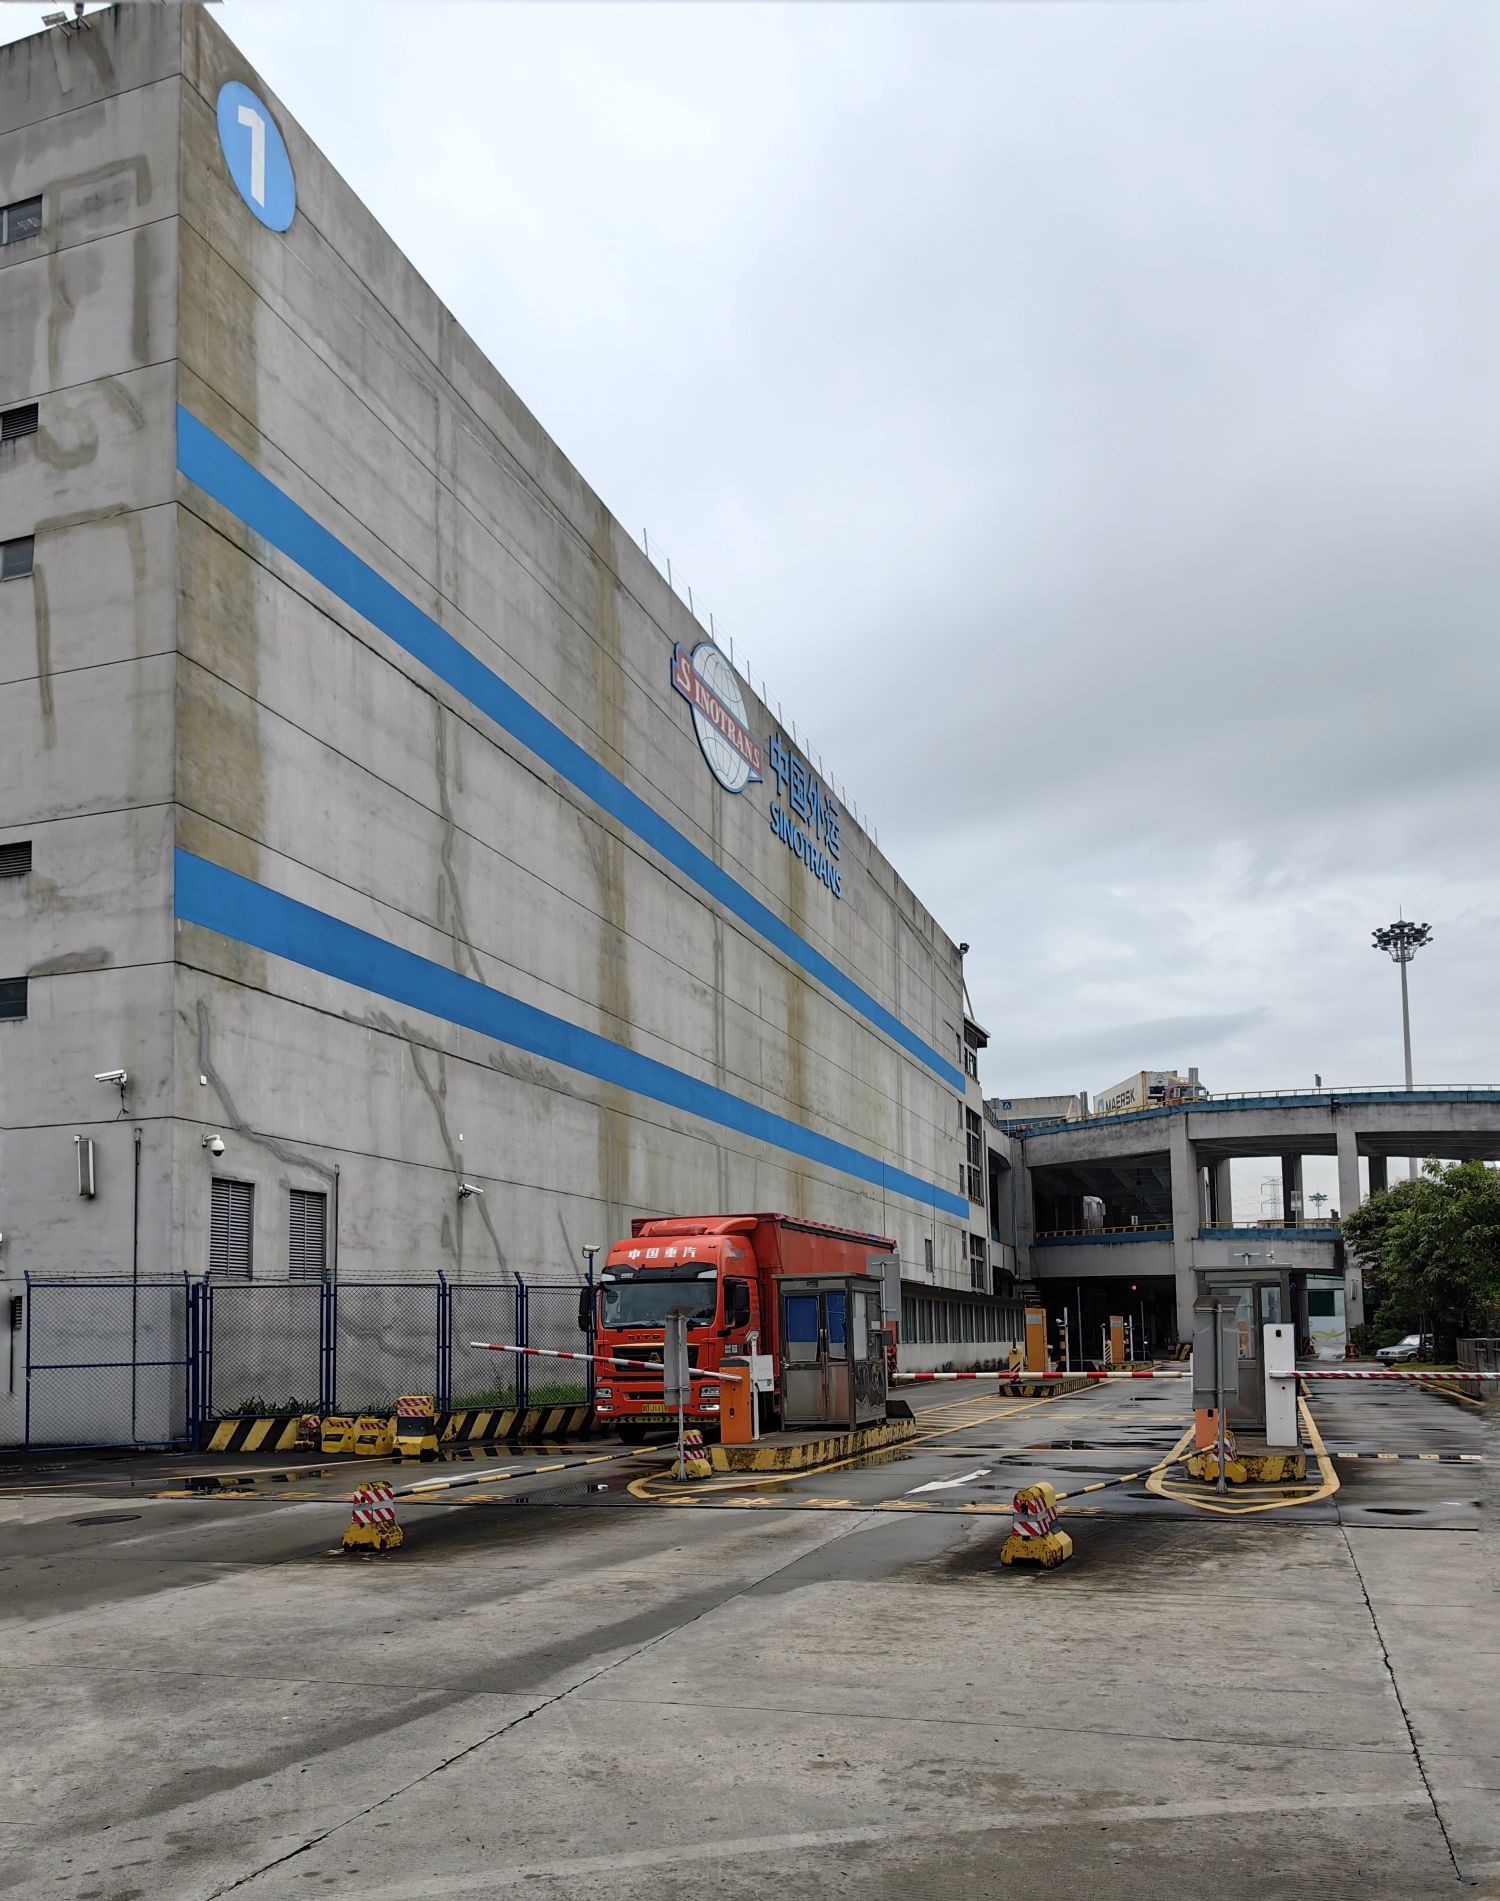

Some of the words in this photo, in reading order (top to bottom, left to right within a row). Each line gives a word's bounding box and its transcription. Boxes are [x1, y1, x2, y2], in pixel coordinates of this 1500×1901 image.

[238, 105, 265, 209] 1
[677, 657, 761, 769] SINOTRANS
[769, 732, 840, 861] 中国外运
[770, 801, 842, 899] SINOTRANS
[1105, 1087, 1136, 1112] MAERSK
[628, 1246, 697, 1260] 中国重汽
